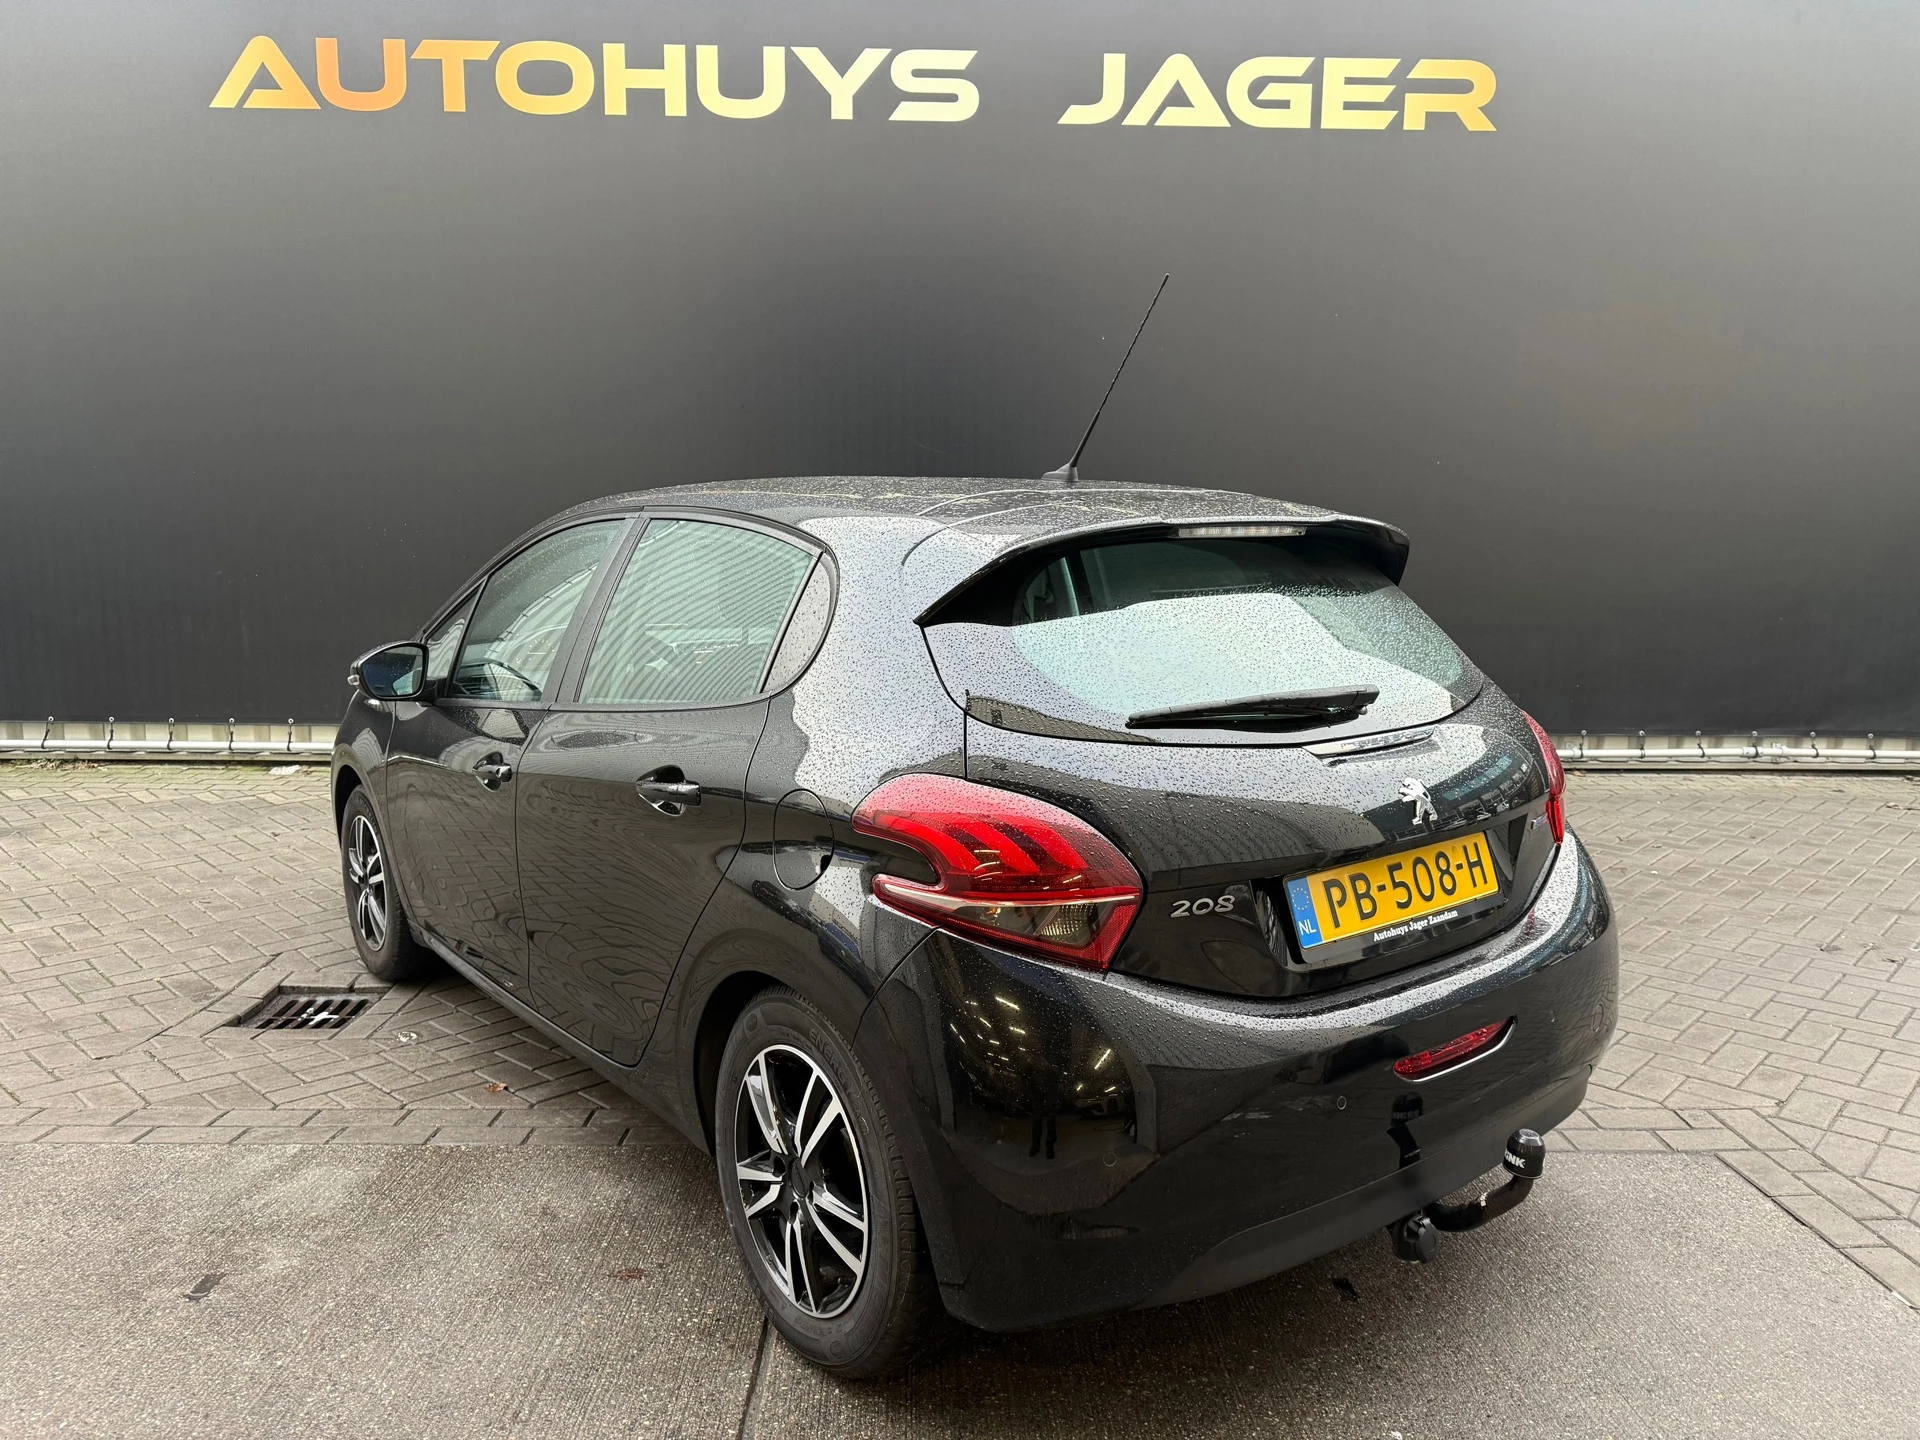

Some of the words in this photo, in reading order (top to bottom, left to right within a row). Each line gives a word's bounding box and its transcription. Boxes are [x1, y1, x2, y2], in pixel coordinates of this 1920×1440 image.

[209, 35, 979, 122] AUTOHUYS
[1057, 53, 1496, 131] JAGER
[1170, 895, 1236, 918] 208
[1323, 842, 1489, 929] PB-508-H
[1298, 919, 1317, 936] NL
[1373, 925, 1409, 942] Autohuys
[1409, 918, 1429, 931] Jager
[1428, 910, 1459, 925] Zaandam
[809, 1028, 857, 1095] ENERGY
